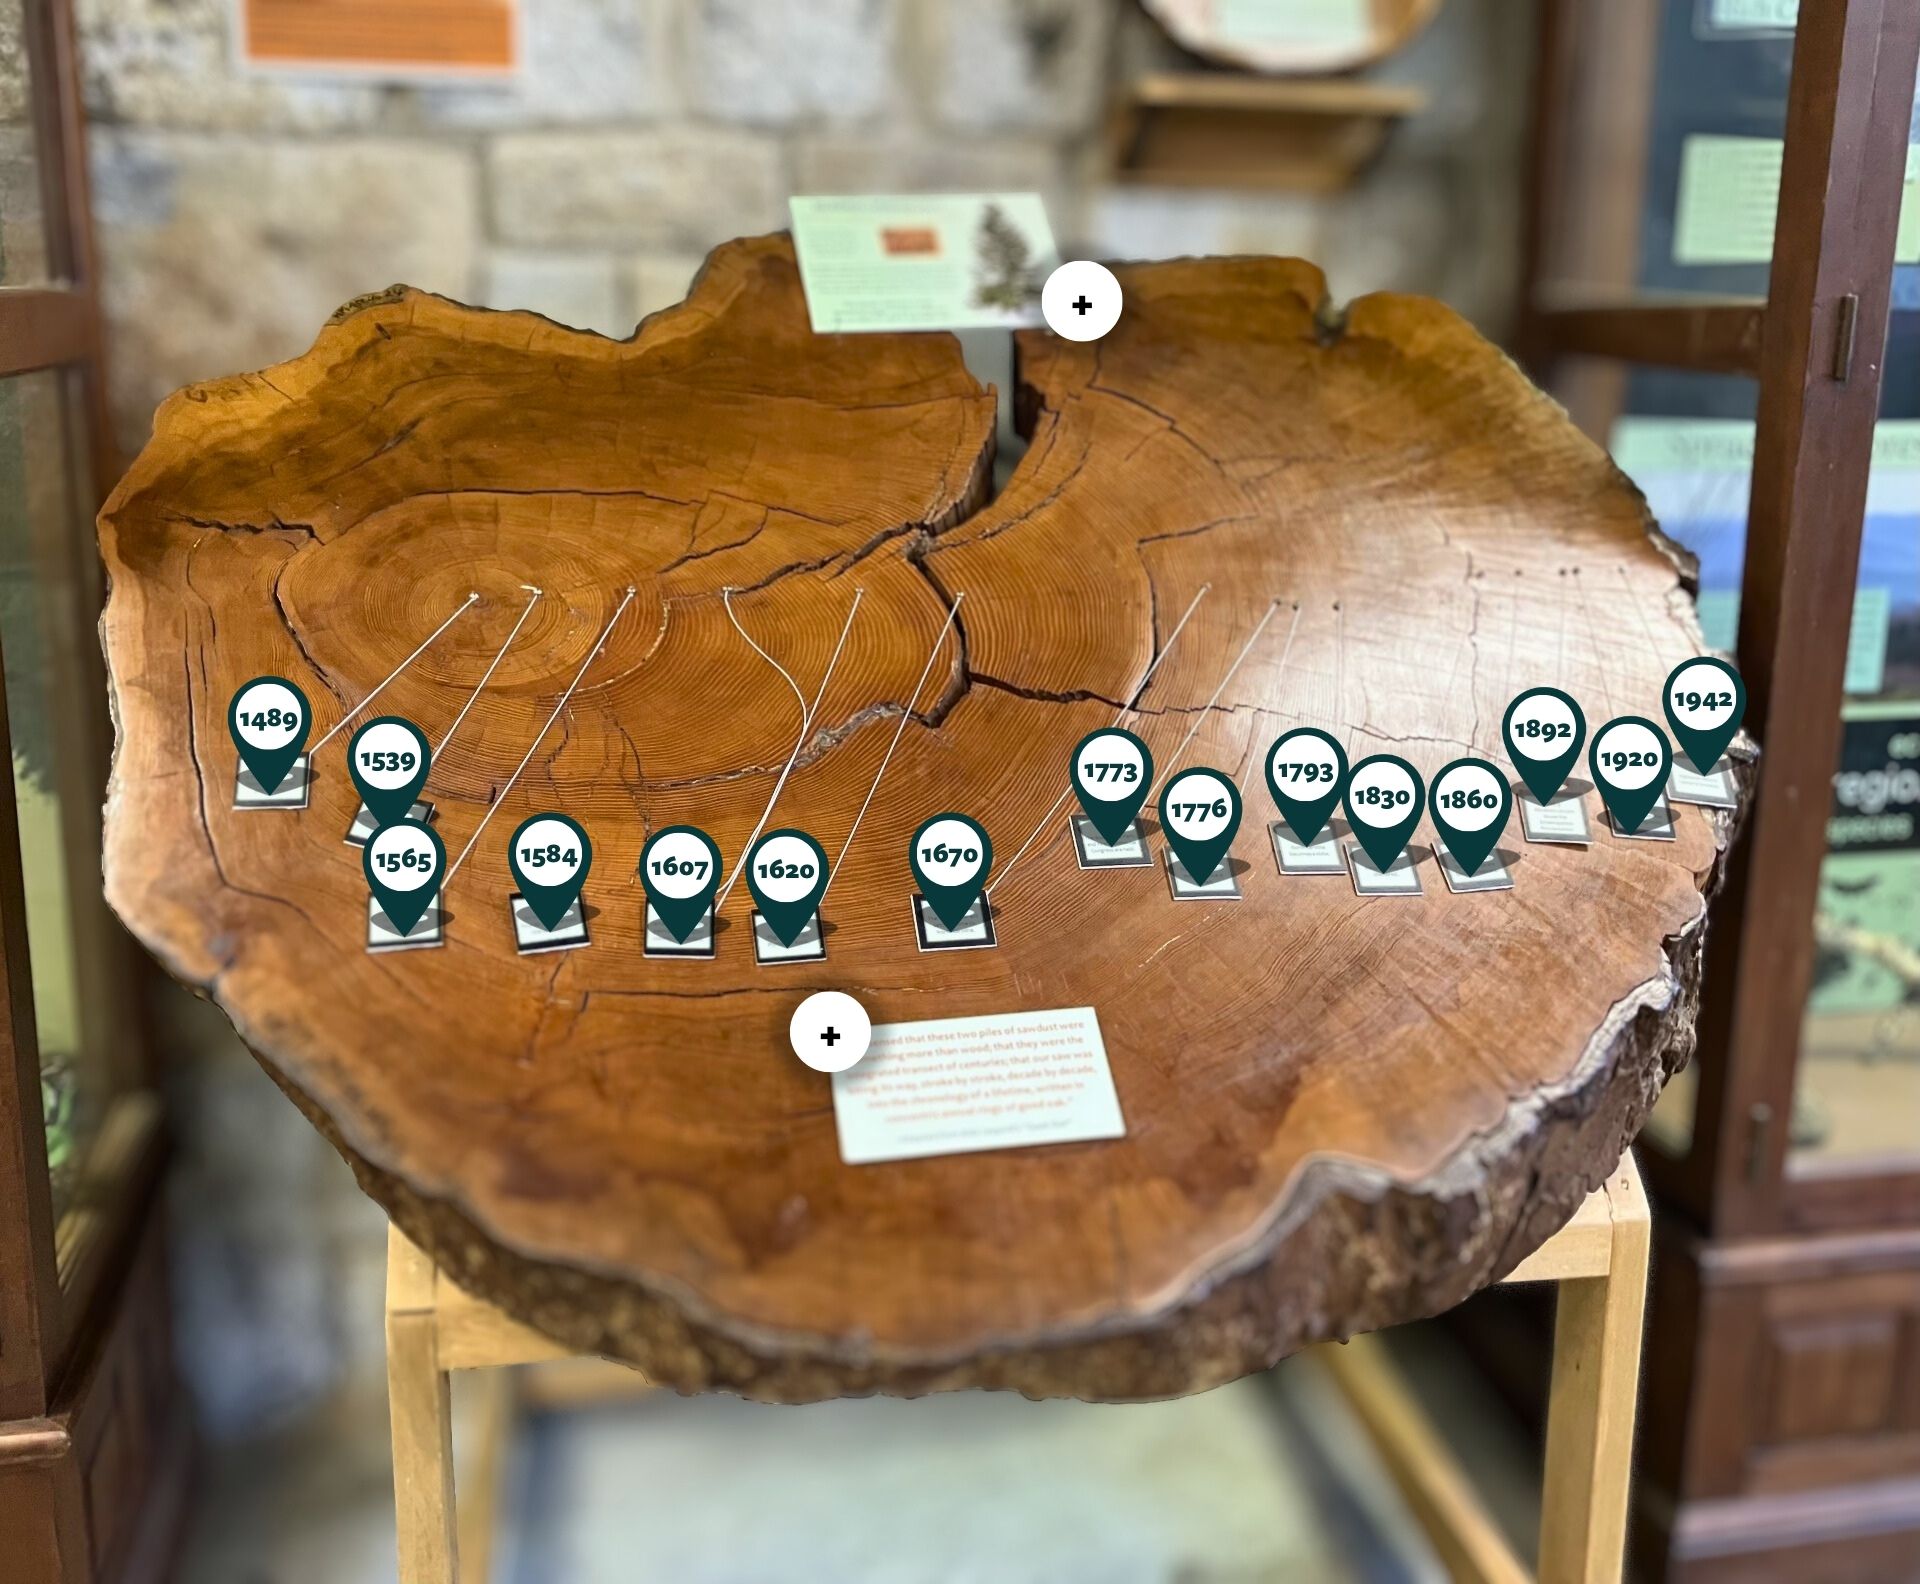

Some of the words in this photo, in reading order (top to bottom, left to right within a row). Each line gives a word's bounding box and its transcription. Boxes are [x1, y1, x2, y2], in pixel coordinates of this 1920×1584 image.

[904, 1033, 926, 1043] that
[928, 1031, 954, 1041] these
[957, 1029, 977, 1039] two
[979, 1027, 1001, 1039] piles
[1004, 1026, 1013, 1035] of
[1017, 1022, 1059, 1034] sawdust
[1061, 1022, 1083, 1030] were
[907, 1050, 932, 1058] more
[935, 1046, 958, 1055] than
[993, 1041, 1013, 1050] that
[1015, 1039, 1038, 1051] they
[1040, 1039, 1064, 1047] were
[1067, 1035, 1083, 1044] the
[946, 1061, 956, 1069] of
[1009, 1055, 1029, 1064] that
